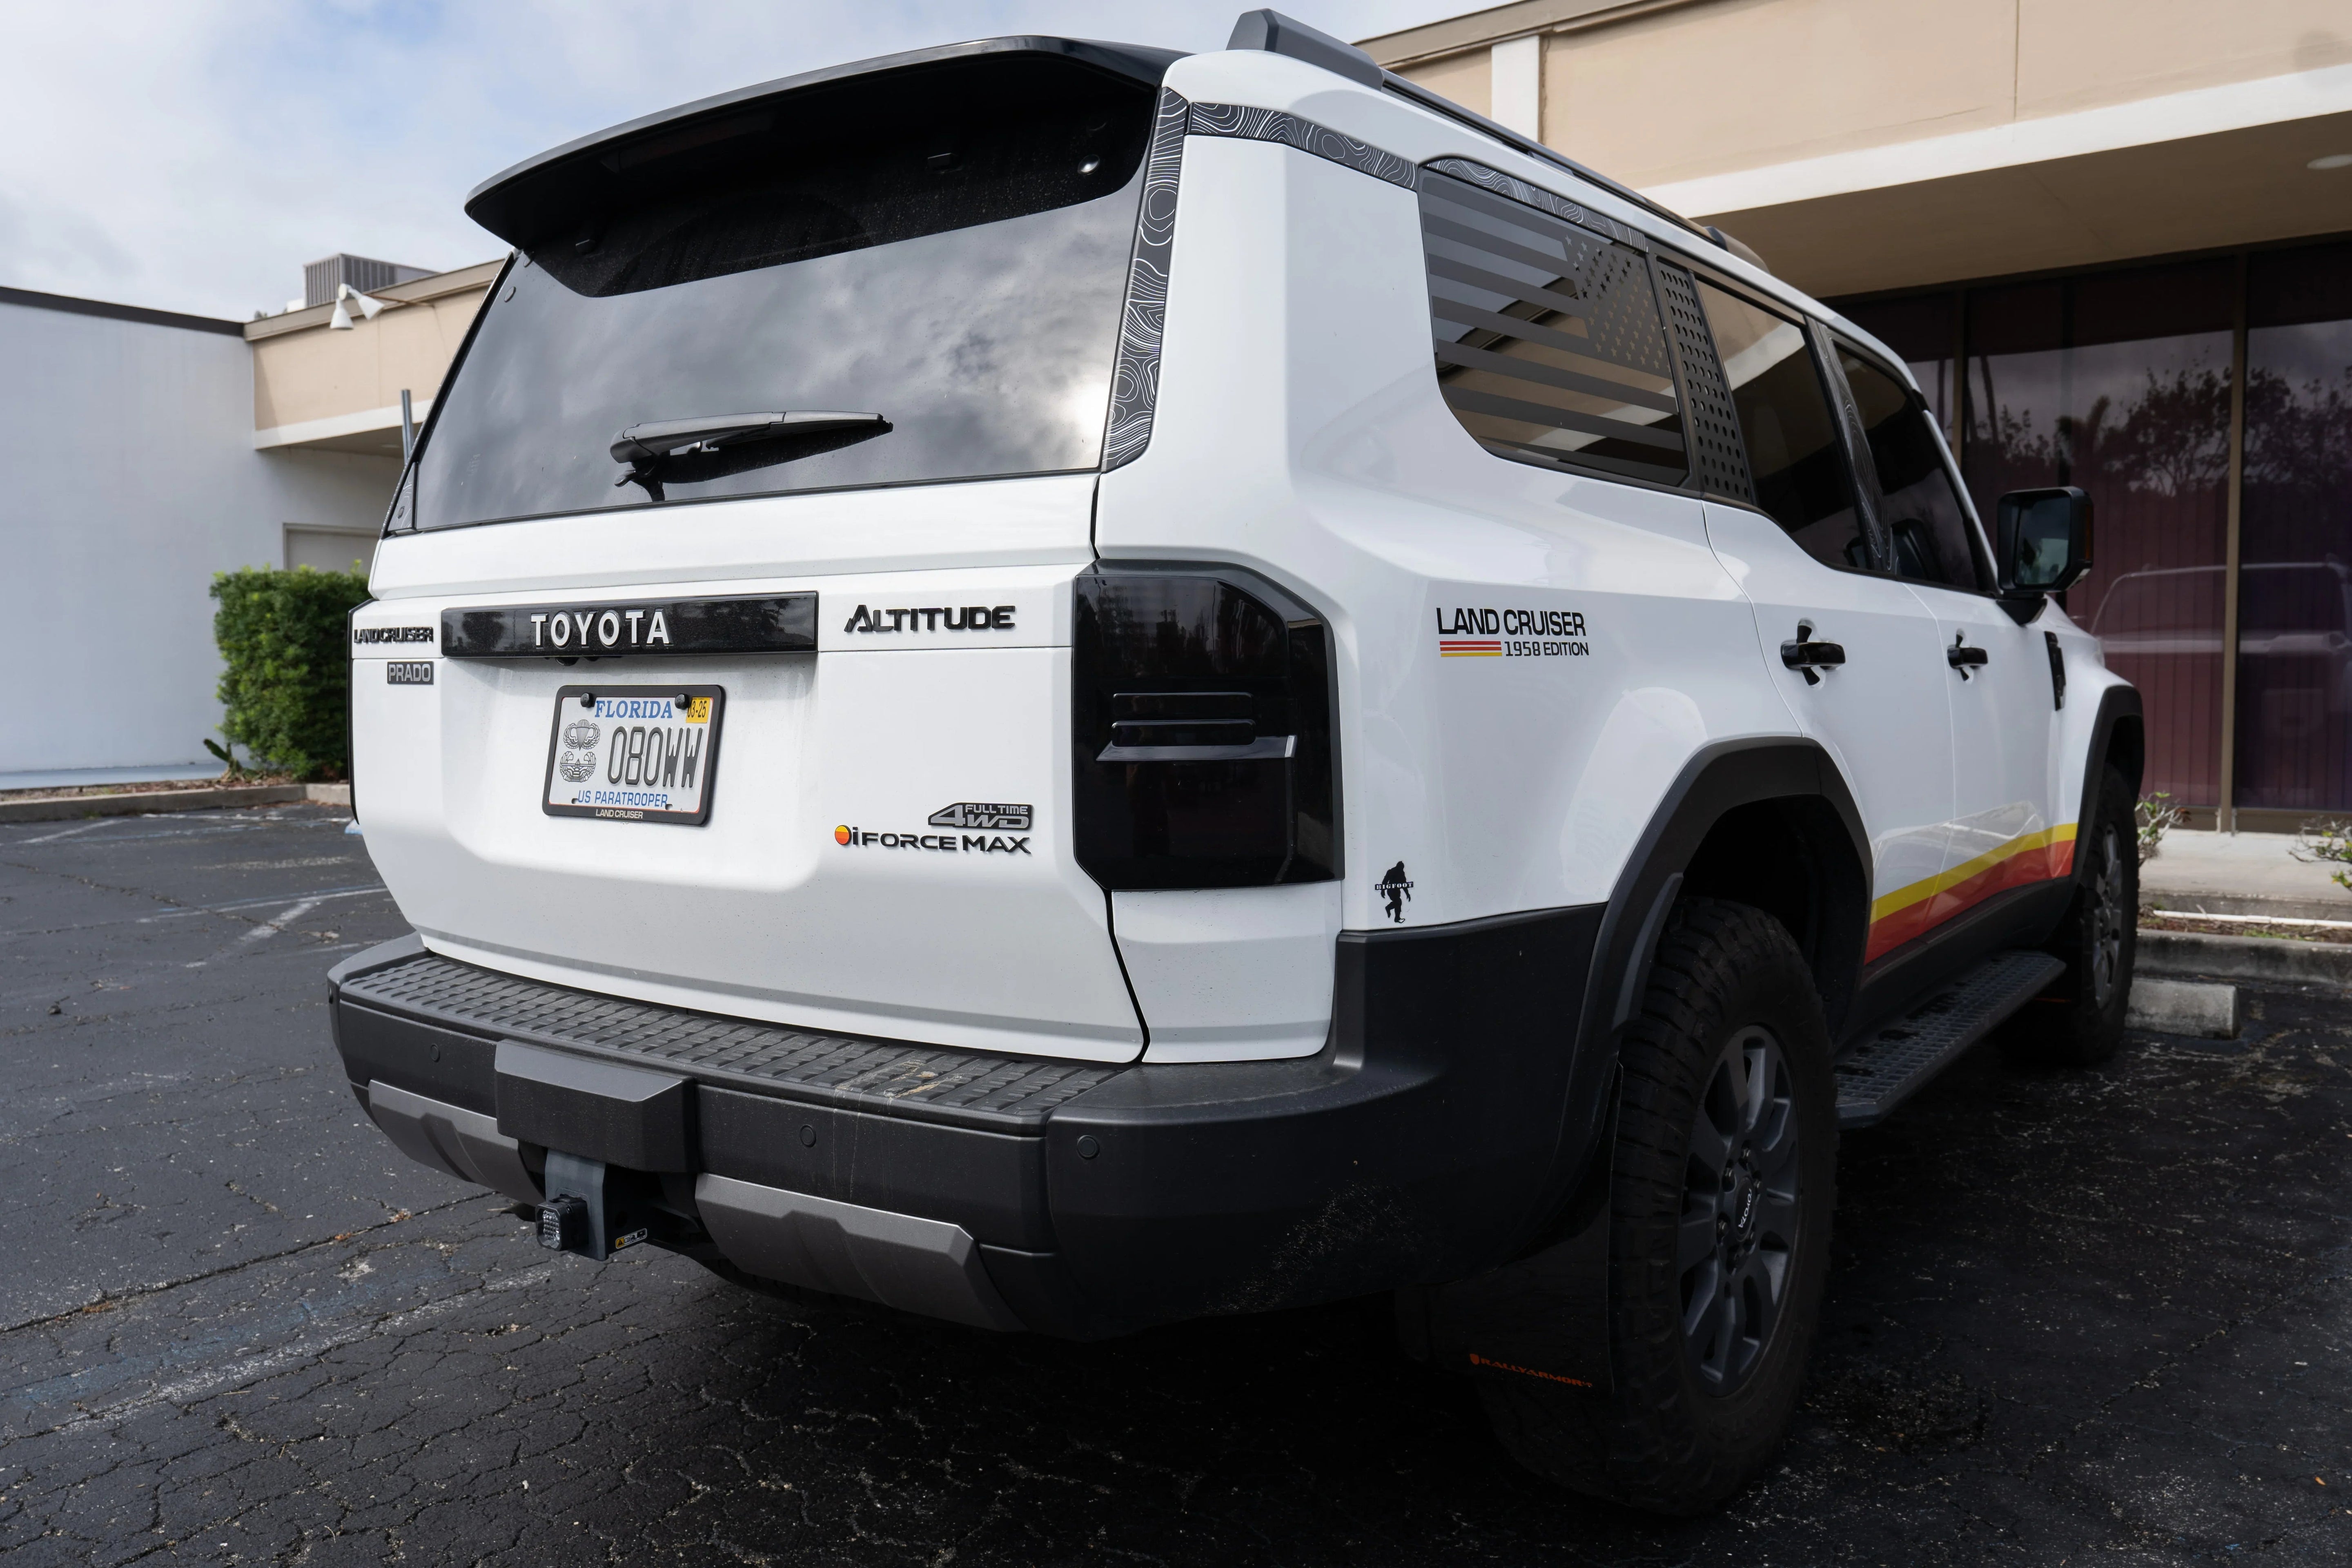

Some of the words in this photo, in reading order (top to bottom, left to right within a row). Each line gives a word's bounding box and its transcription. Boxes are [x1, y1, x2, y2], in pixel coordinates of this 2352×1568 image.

[844, 605, 1016, 632] ALTITUDE
[1436, 607, 1500, 635] LAND
[1503, 609, 1586, 636] CRUISER
[531, 609, 672, 648] TOYOTA
[1505, 641, 1541, 656] 1958
[1543, 642, 1589, 656] EDITION
[388, 664, 431, 682] PRADO
[595, 700, 673, 719] FLORIDA
[578, 790, 591, 803] US
[595, 791, 668, 807] PARATROOPER
[615, 810, 643, 819] CRUISER
[931, 805, 1029, 829] 4WD
[965, 804, 996, 814] FULL
[998, 806, 1028, 815] TIME
[962, 835, 1031, 854] MAX
[1738, 1188, 1752, 1228] TOYOTA
